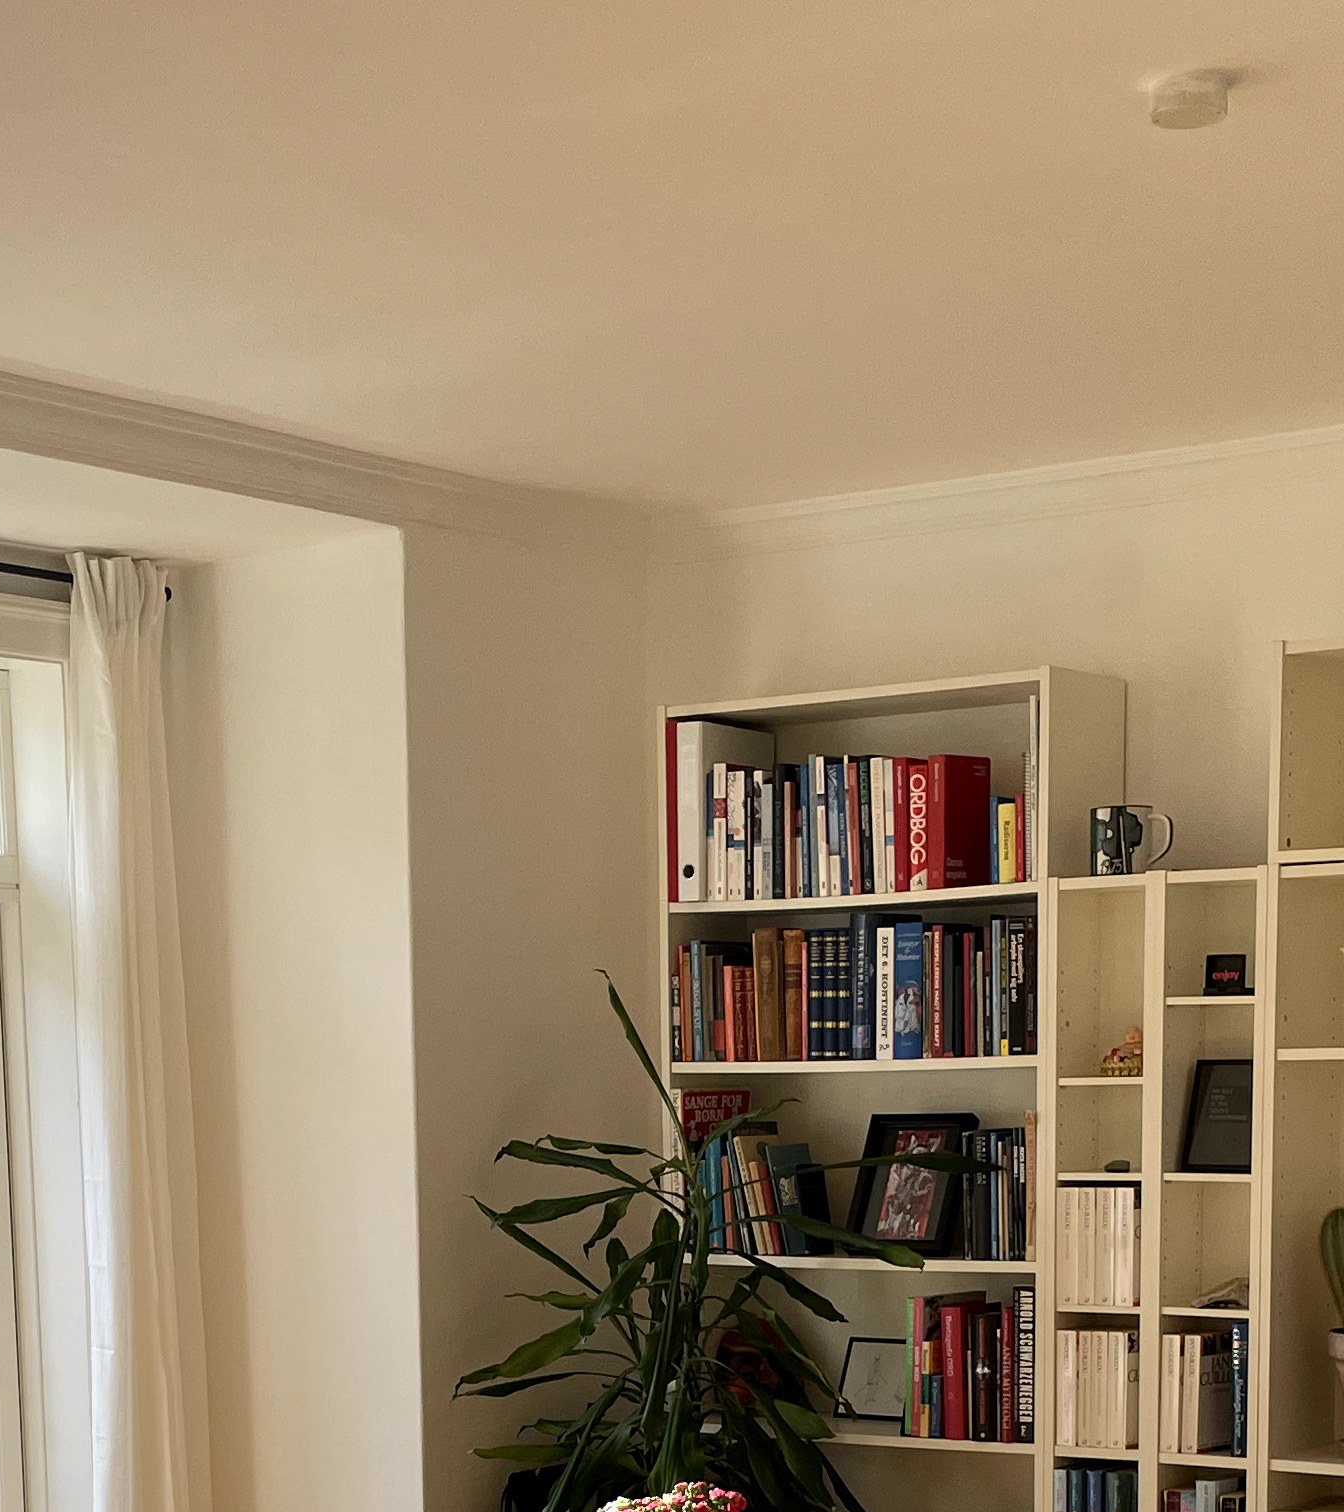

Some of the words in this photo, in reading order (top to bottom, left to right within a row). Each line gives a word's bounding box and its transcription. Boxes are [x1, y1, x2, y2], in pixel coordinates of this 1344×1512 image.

[909, 773, 927, 866] ORDBOG
[881, 936, 890, 958] DET
[1211, 969, 1240, 983] enjoy
[880, 973, 890, 1039] KONTINENT
[684, 1096, 719, 1110] SANGE
[721, 1094, 743, 1109] FOR
[1018, 1289, 1034, 1330] ARNOLD
[945, 1357, 954, 1378] ORD
[1002, 1345, 1012, 1375] ANTIK
[1018, 1332, 1034, 1424] SCHWARZENEGGER
[1002, 1377, 1011, 1430] MYTOLOGI
